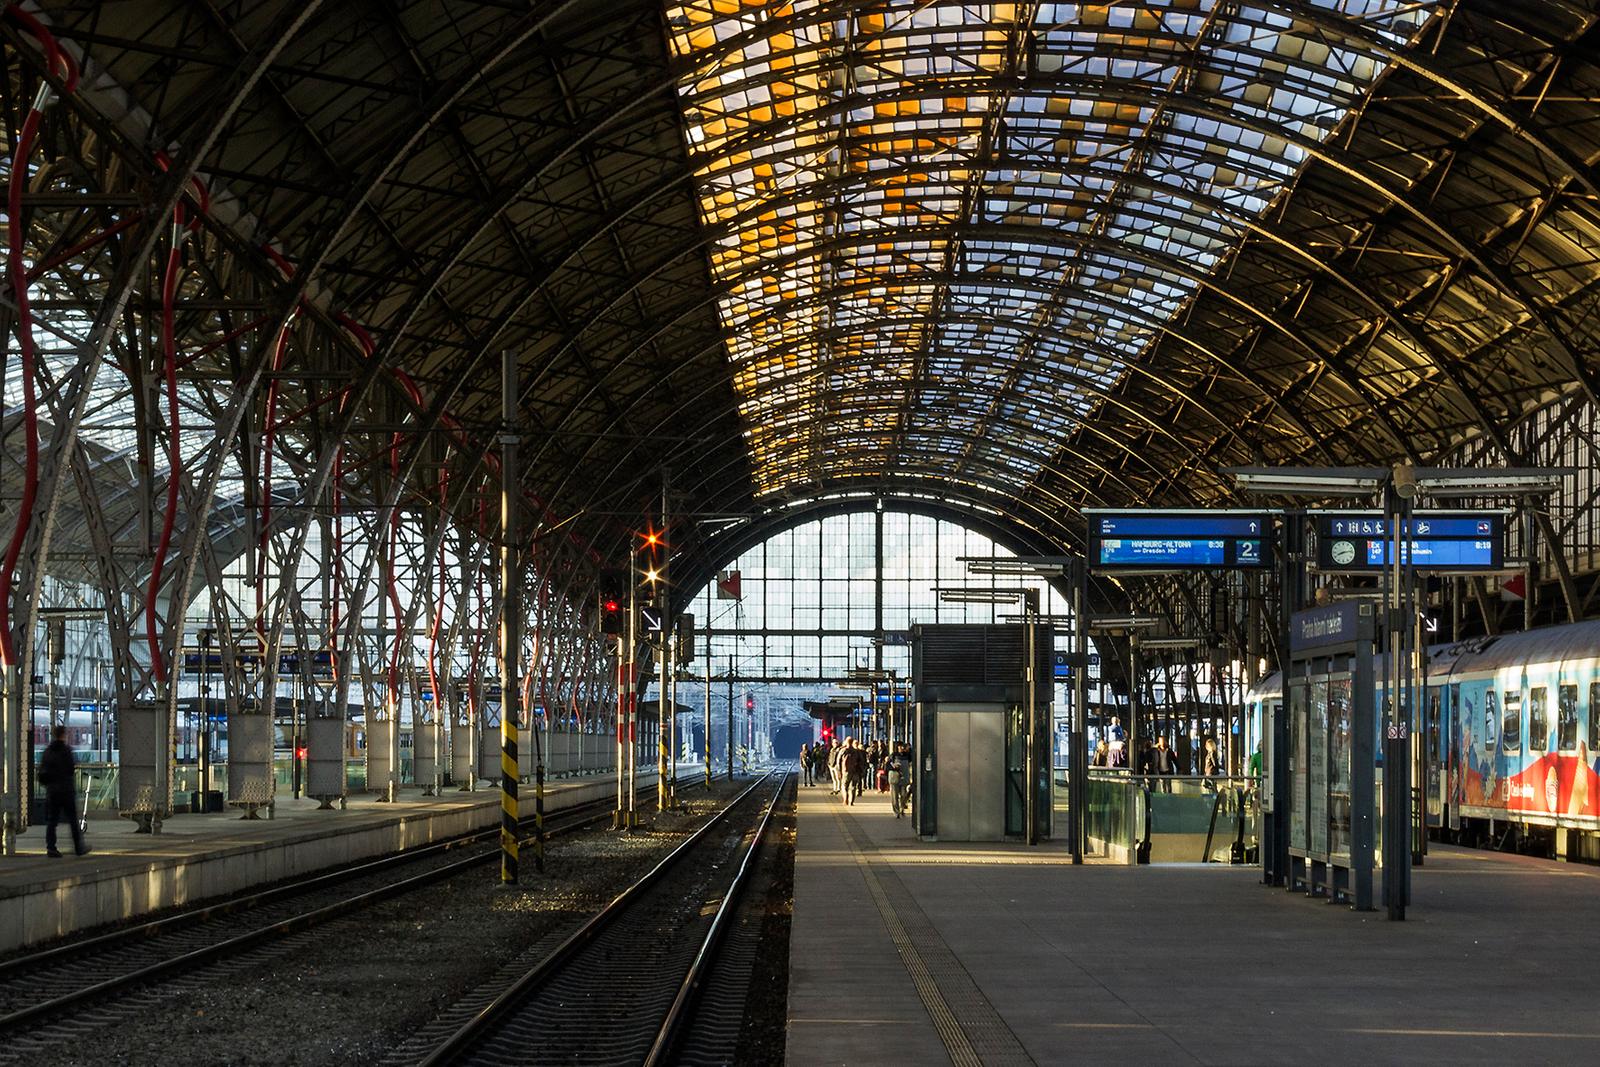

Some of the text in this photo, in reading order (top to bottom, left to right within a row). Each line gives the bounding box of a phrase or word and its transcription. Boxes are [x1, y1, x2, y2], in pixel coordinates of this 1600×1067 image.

[1131, 541, 1192, 549] HAMBURG-ALTONA
[1208, 541, 1224, 549] 8:30
[1475, 541, 1491, 549] 8:10
[1057, 656, 1064, 664] D
